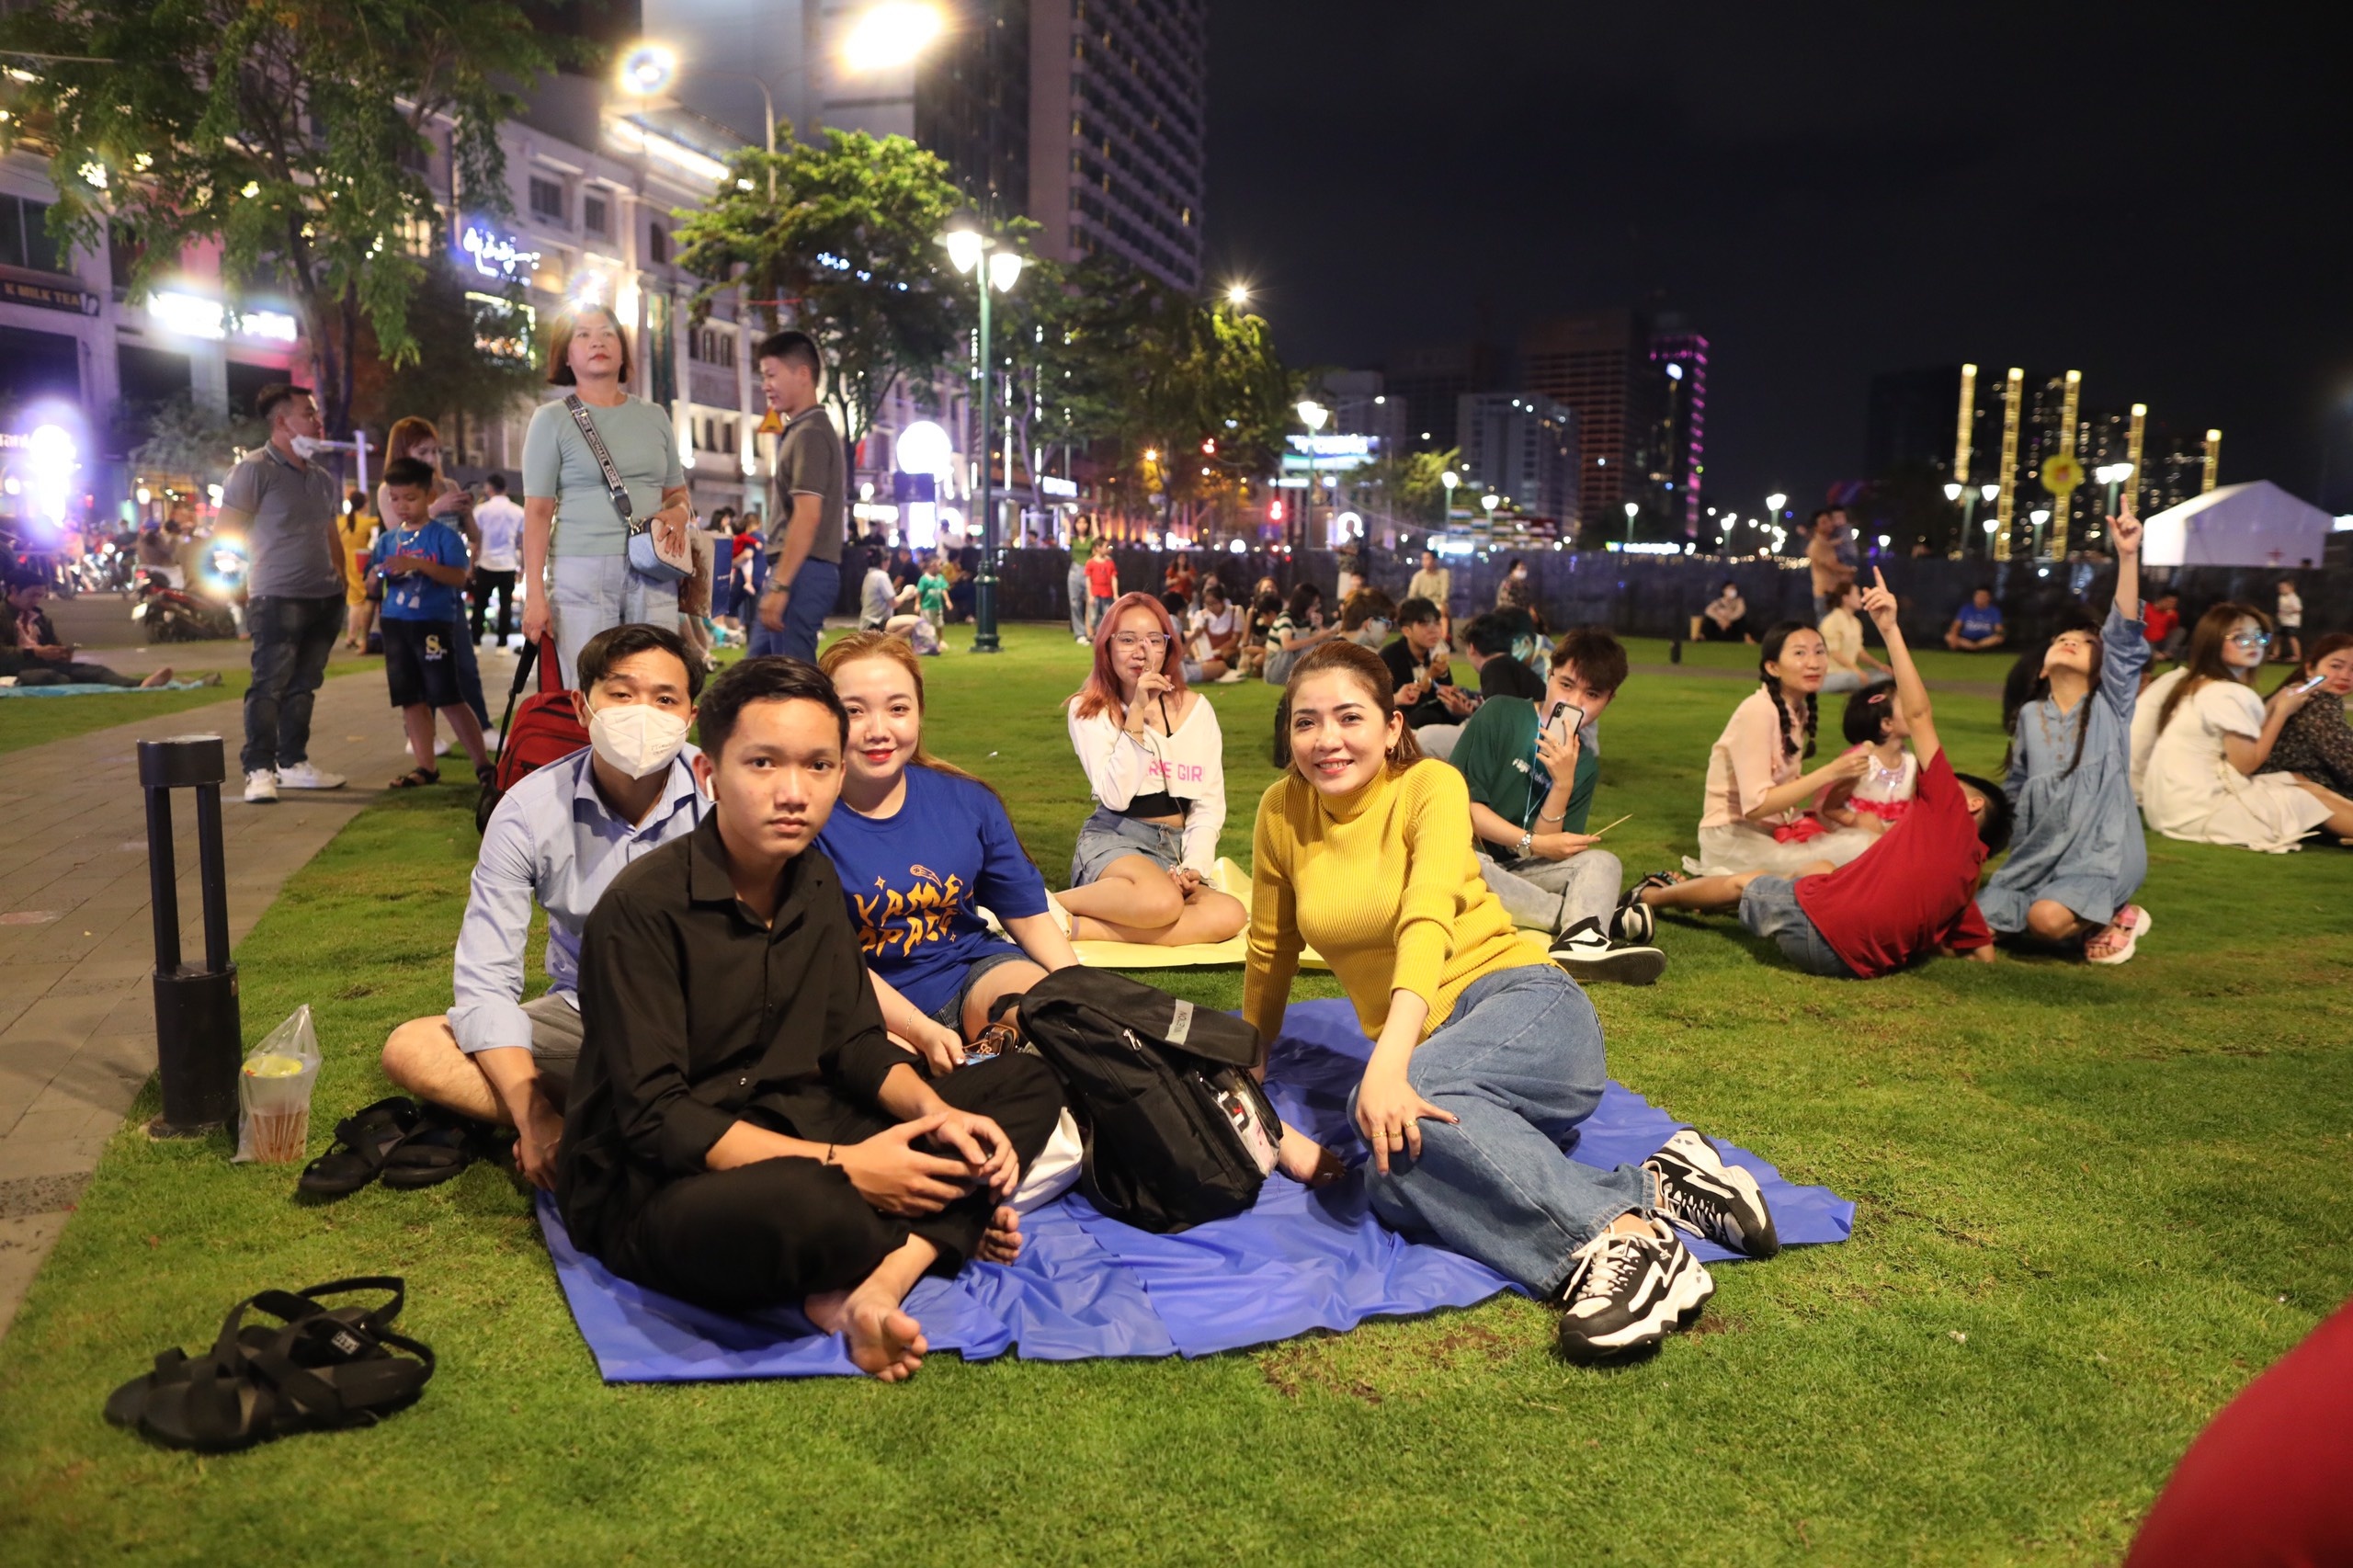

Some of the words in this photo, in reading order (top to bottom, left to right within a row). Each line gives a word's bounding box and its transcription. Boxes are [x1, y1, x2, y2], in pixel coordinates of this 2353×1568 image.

[53, 290, 80, 307] TEA
[604, 464, 620, 487] KORS
[1177, 763, 1206, 782] GIR
